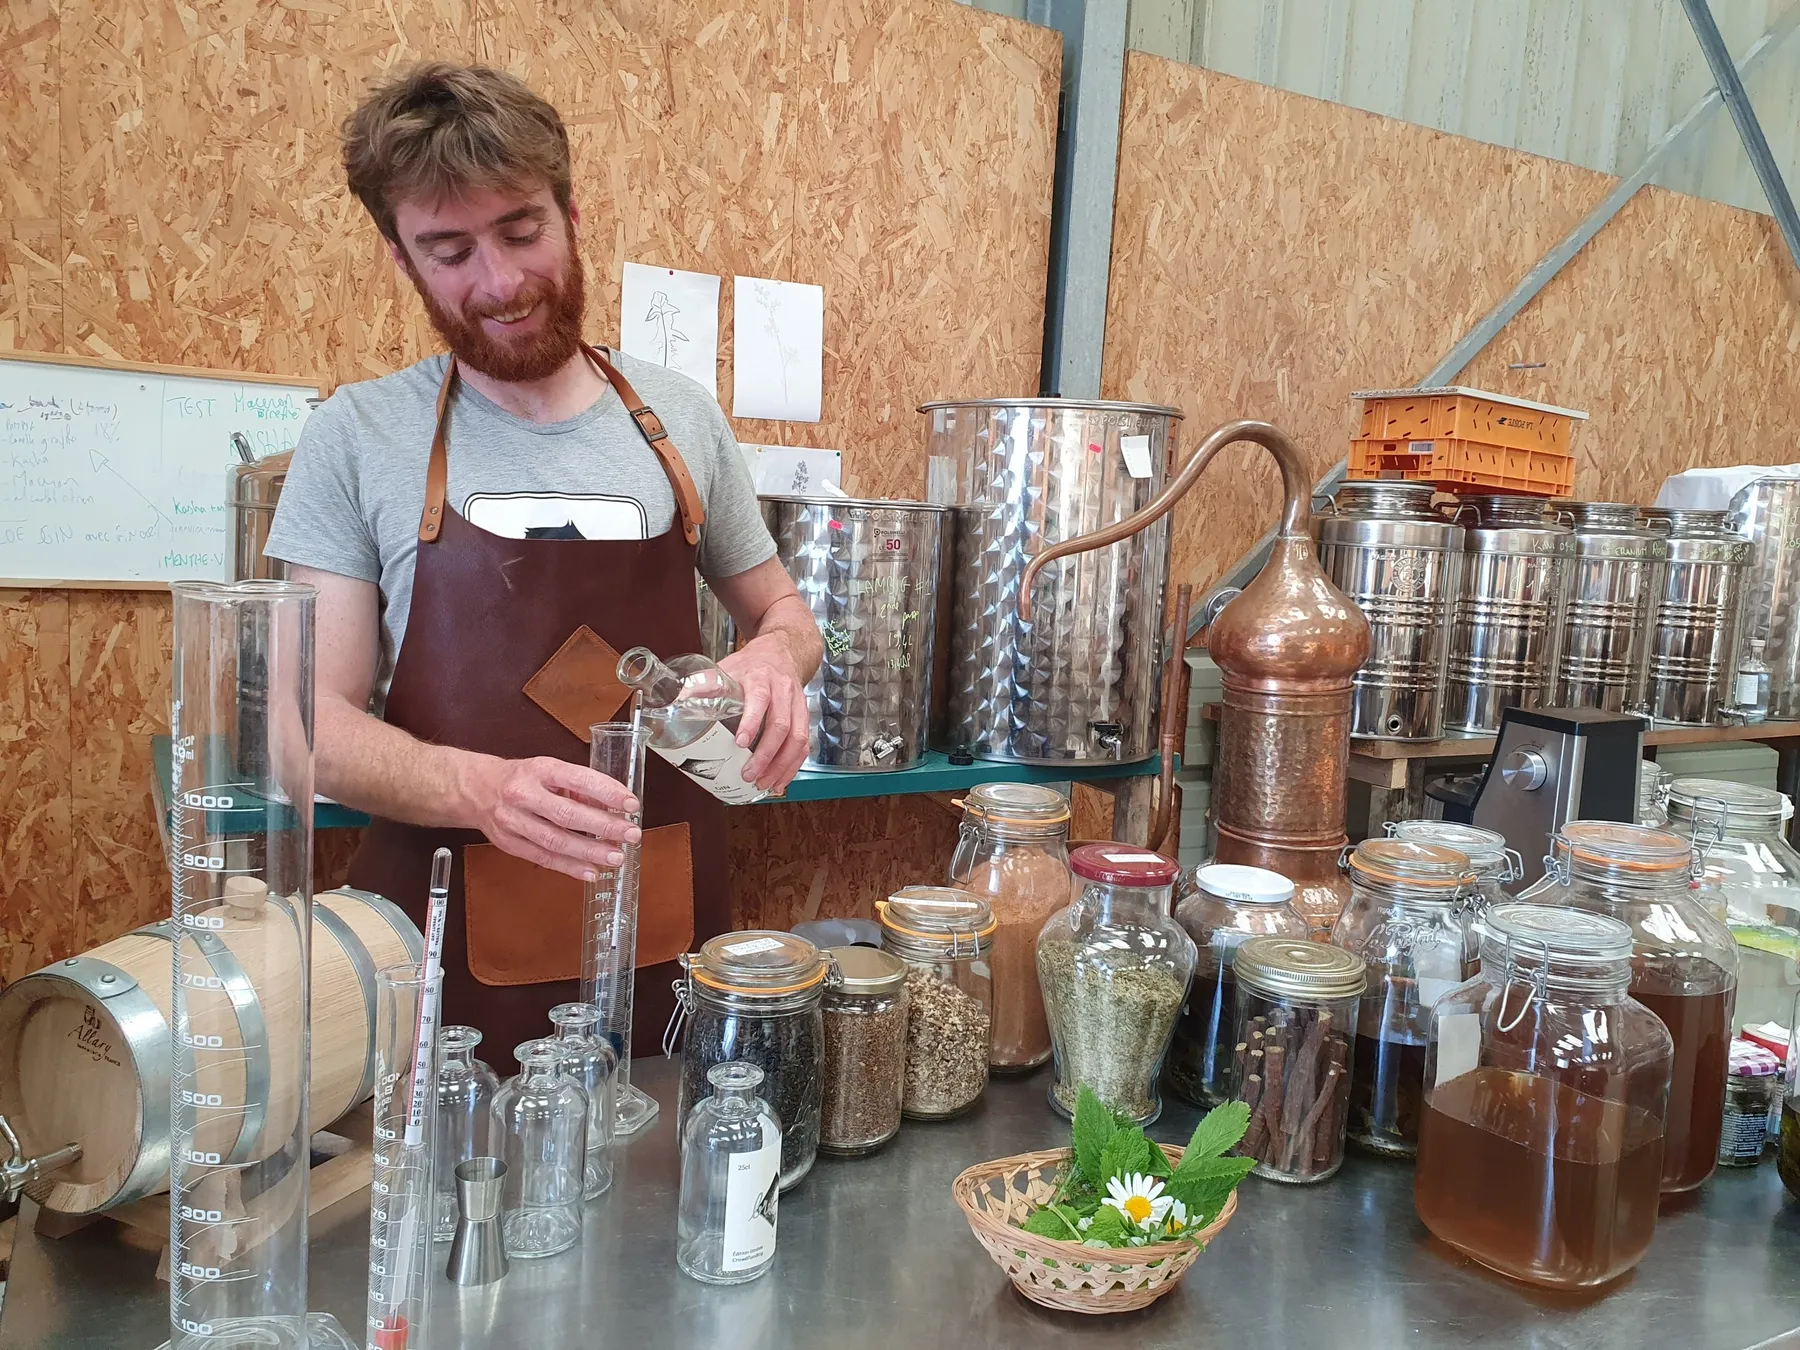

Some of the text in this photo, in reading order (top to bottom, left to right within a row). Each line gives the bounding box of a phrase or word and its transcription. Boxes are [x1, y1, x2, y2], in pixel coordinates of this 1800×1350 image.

[167, 396, 216, 418] TEST
[1508, 418, 1525, 429] POSTE
[886, 539, 901, 550] 50
[184, 794, 233, 808] 1000
[183, 854, 224, 869] 900
[183, 914, 224, 929] 800
[183, 973, 222, 988] 700
[68, 1024, 112, 1061] Allary
[182, 1033, 222, 1048] 600
[182, 1090, 222, 1106] 500
[182, 1149, 221, 1164] 400
[374, 1154, 389, 1165] 90
[738, 1163, 751, 1171] 25cl
[374, 1181, 389, 1192] 80
[182, 1207, 221, 1222] 300
[372, 1208, 387, 1220] 70
[372, 1235, 386, 1247] 60
[181, 1263, 221, 1278] 200
[371, 1262, 385, 1274] 50
[370, 1290, 384, 1301] 40
[181, 1319, 213, 1335] 100
[369, 1316, 384, 1328] 30
